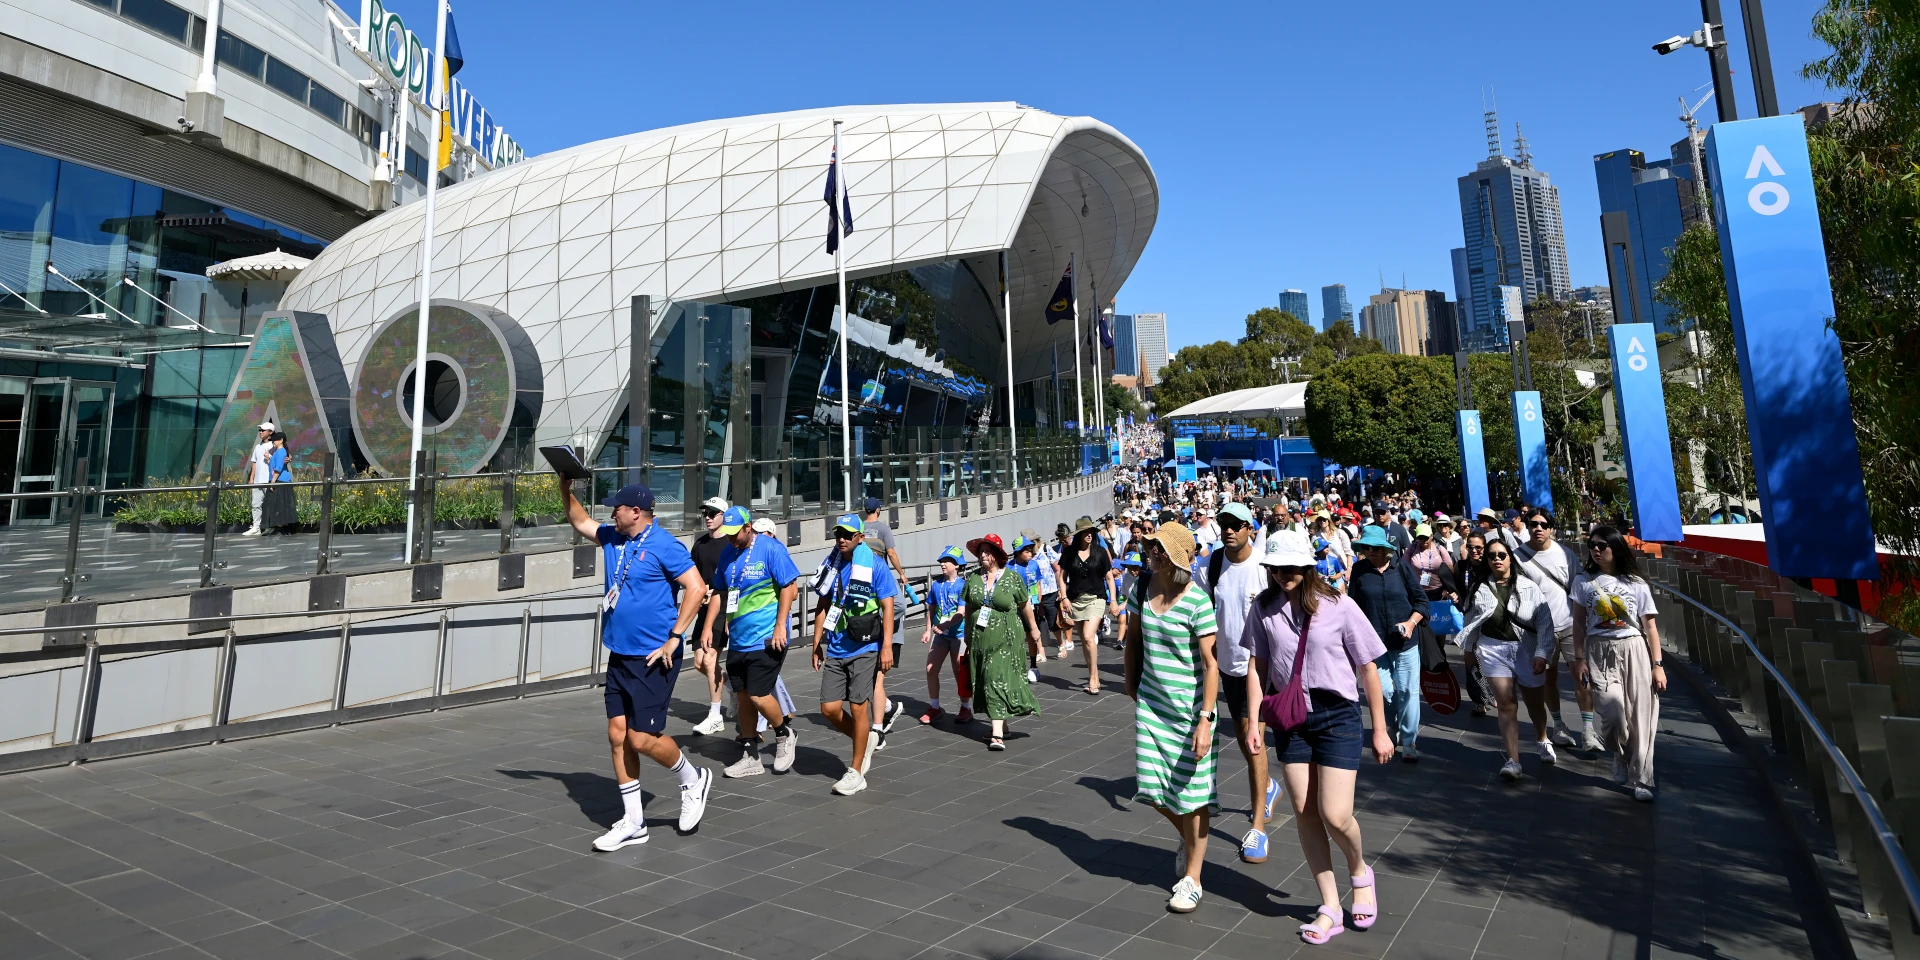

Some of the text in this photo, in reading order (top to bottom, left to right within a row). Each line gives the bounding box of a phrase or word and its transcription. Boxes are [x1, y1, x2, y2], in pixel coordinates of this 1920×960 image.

[361, 0, 425, 94] ROD
[1745, 145, 1790, 216] AO
[1627, 336, 1648, 371] AO
[194, 298, 543, 478] AO
[1524, 399, 1536, 422] AO
[1466, 416, 1476, 435] AO
